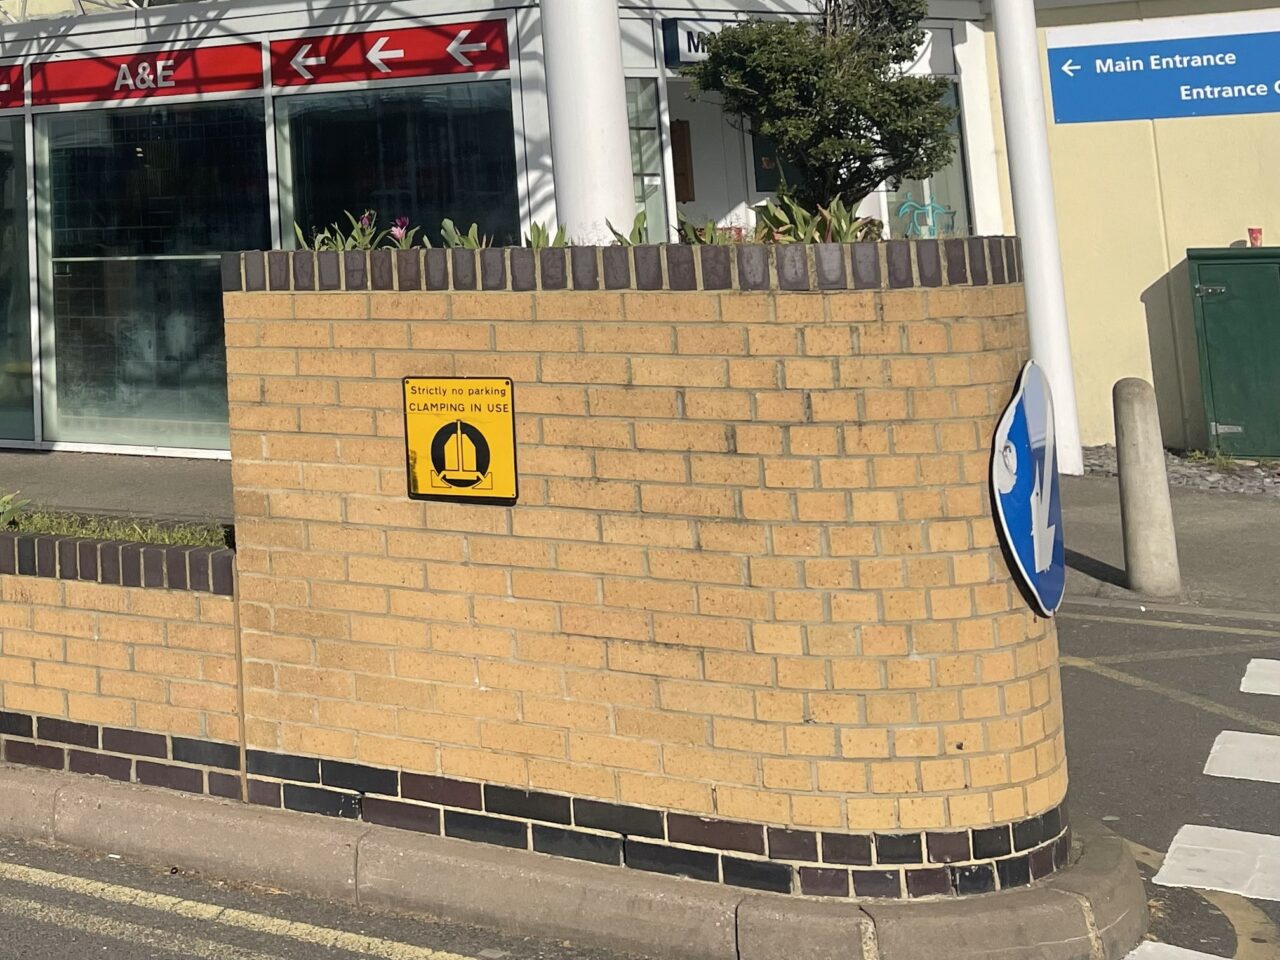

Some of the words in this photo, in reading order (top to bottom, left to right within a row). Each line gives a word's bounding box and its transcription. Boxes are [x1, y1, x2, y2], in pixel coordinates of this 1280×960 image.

[1095, 56, 1144, 74] Main
[1150, 52, 1237, 70] Entrance
[114, 59, 175, 91] A&E
[1180, 83, 1267, 100] Entrance
[410, 385, 448, 397] Strictly
[452, 387, 464, 396] no
[468, 386, 507, 398] parking
[409, 402, 466, 413] CLAMPING
[470, 403, 482, 413] IN
[487, 403, 510, 414] USE
